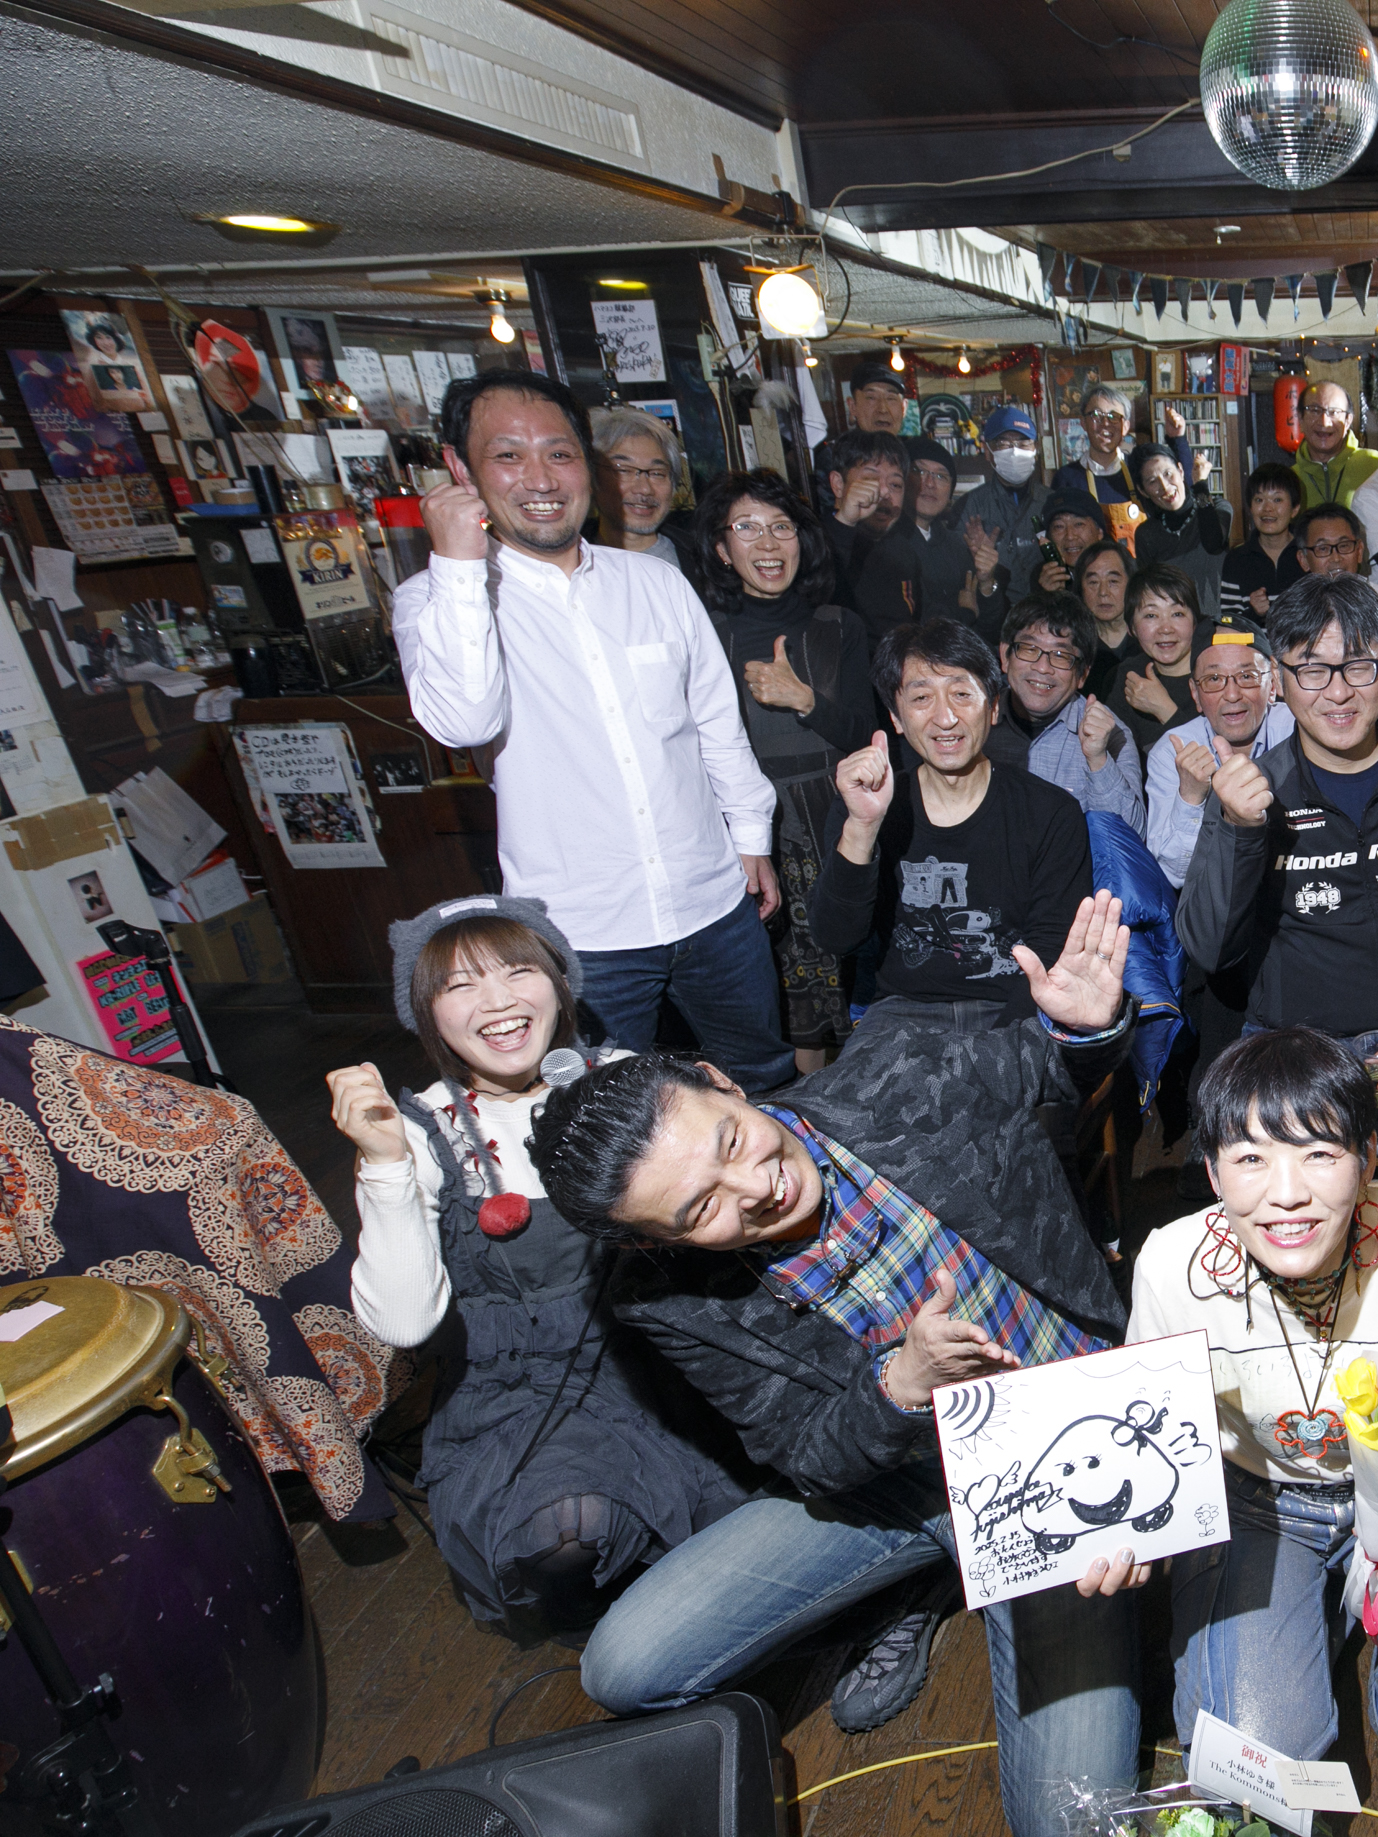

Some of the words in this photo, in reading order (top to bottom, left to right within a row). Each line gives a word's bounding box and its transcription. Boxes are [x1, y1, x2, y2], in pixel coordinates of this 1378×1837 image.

[312, 568, 343, 584] KIRIN
[1285, 808, 1323, 817] HONDA
[1287, 820, 1326, 831] TECHNOLOGY
[1274, 851, 1358, 871] Honda
[1295, 888, 1342, 907] 1948
[1241, 1744, 1267, 1768] 御祝
[1209, 1759, 1228, 1776] The
[1226, 1759, 1276, 1791] 小林ゆき様
